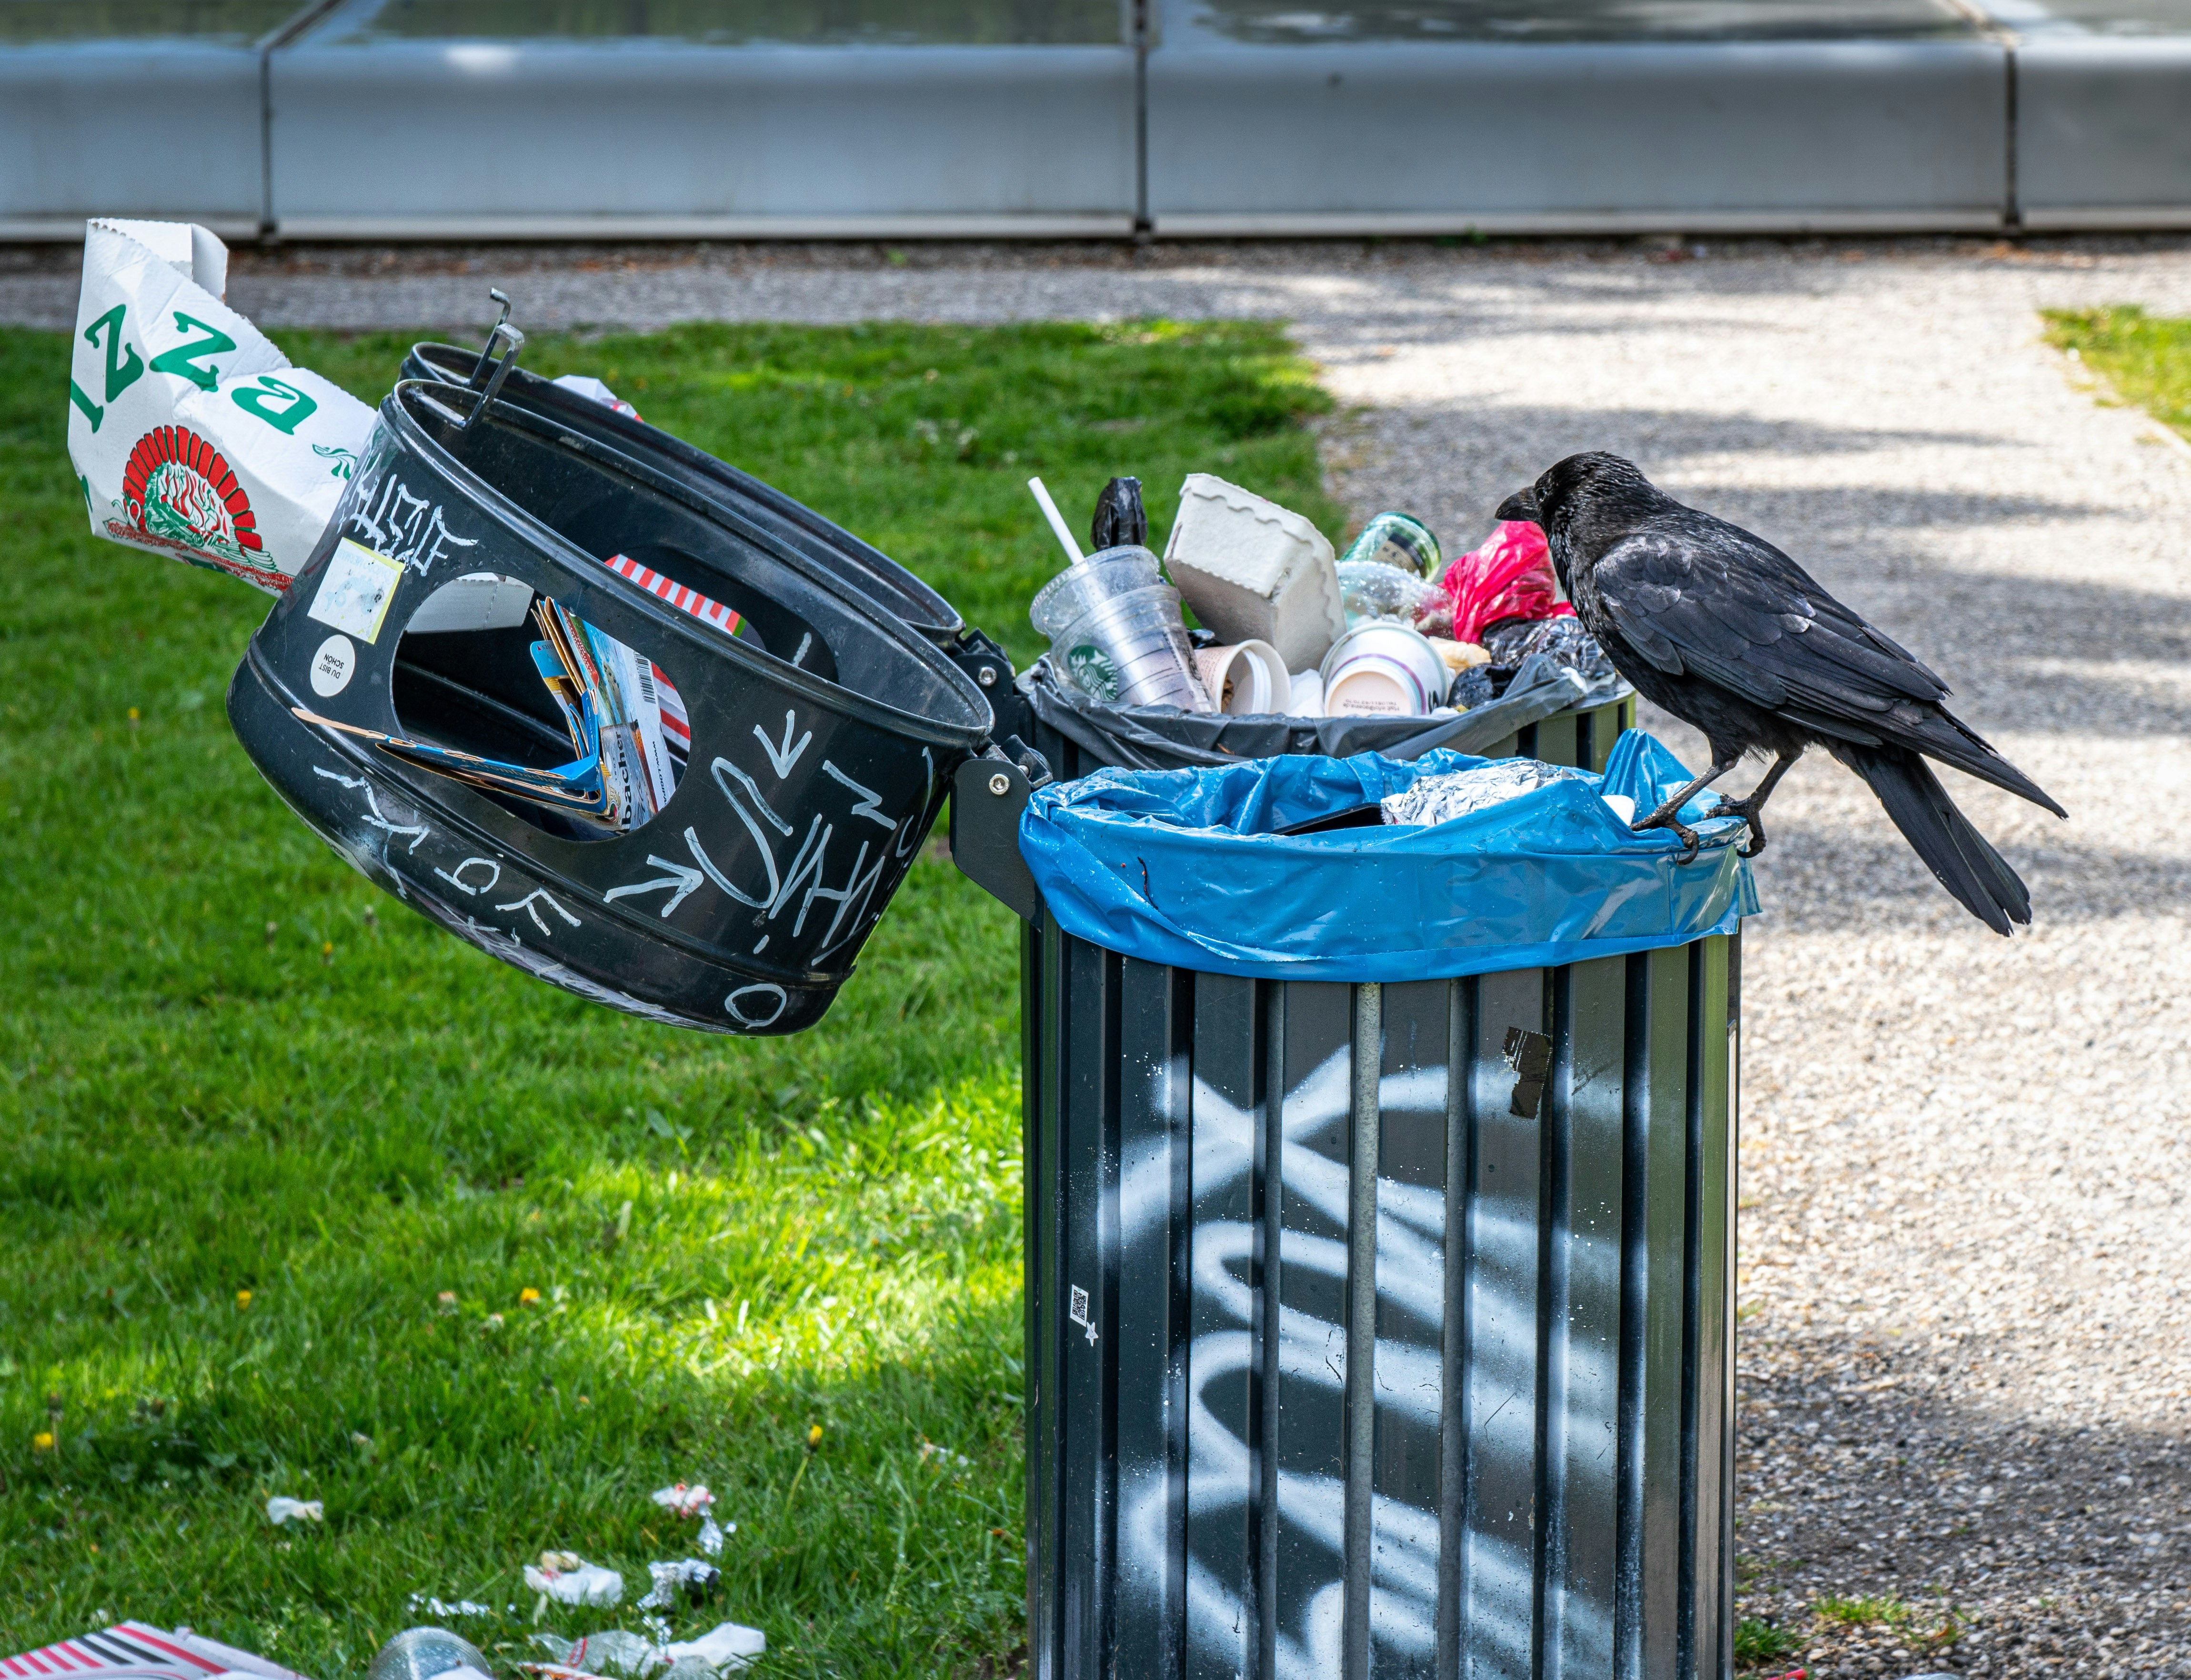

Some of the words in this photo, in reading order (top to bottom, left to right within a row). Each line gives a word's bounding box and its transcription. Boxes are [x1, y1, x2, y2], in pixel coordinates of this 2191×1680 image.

[319, 663, 331, 674] BIST
[323, 653, 344, 669] SCHÖN
[331, 670, 341, 679] DU
[470, 761, 562, 785] Krombacher
[652, 741, 667, 805] www.LOGIPA
